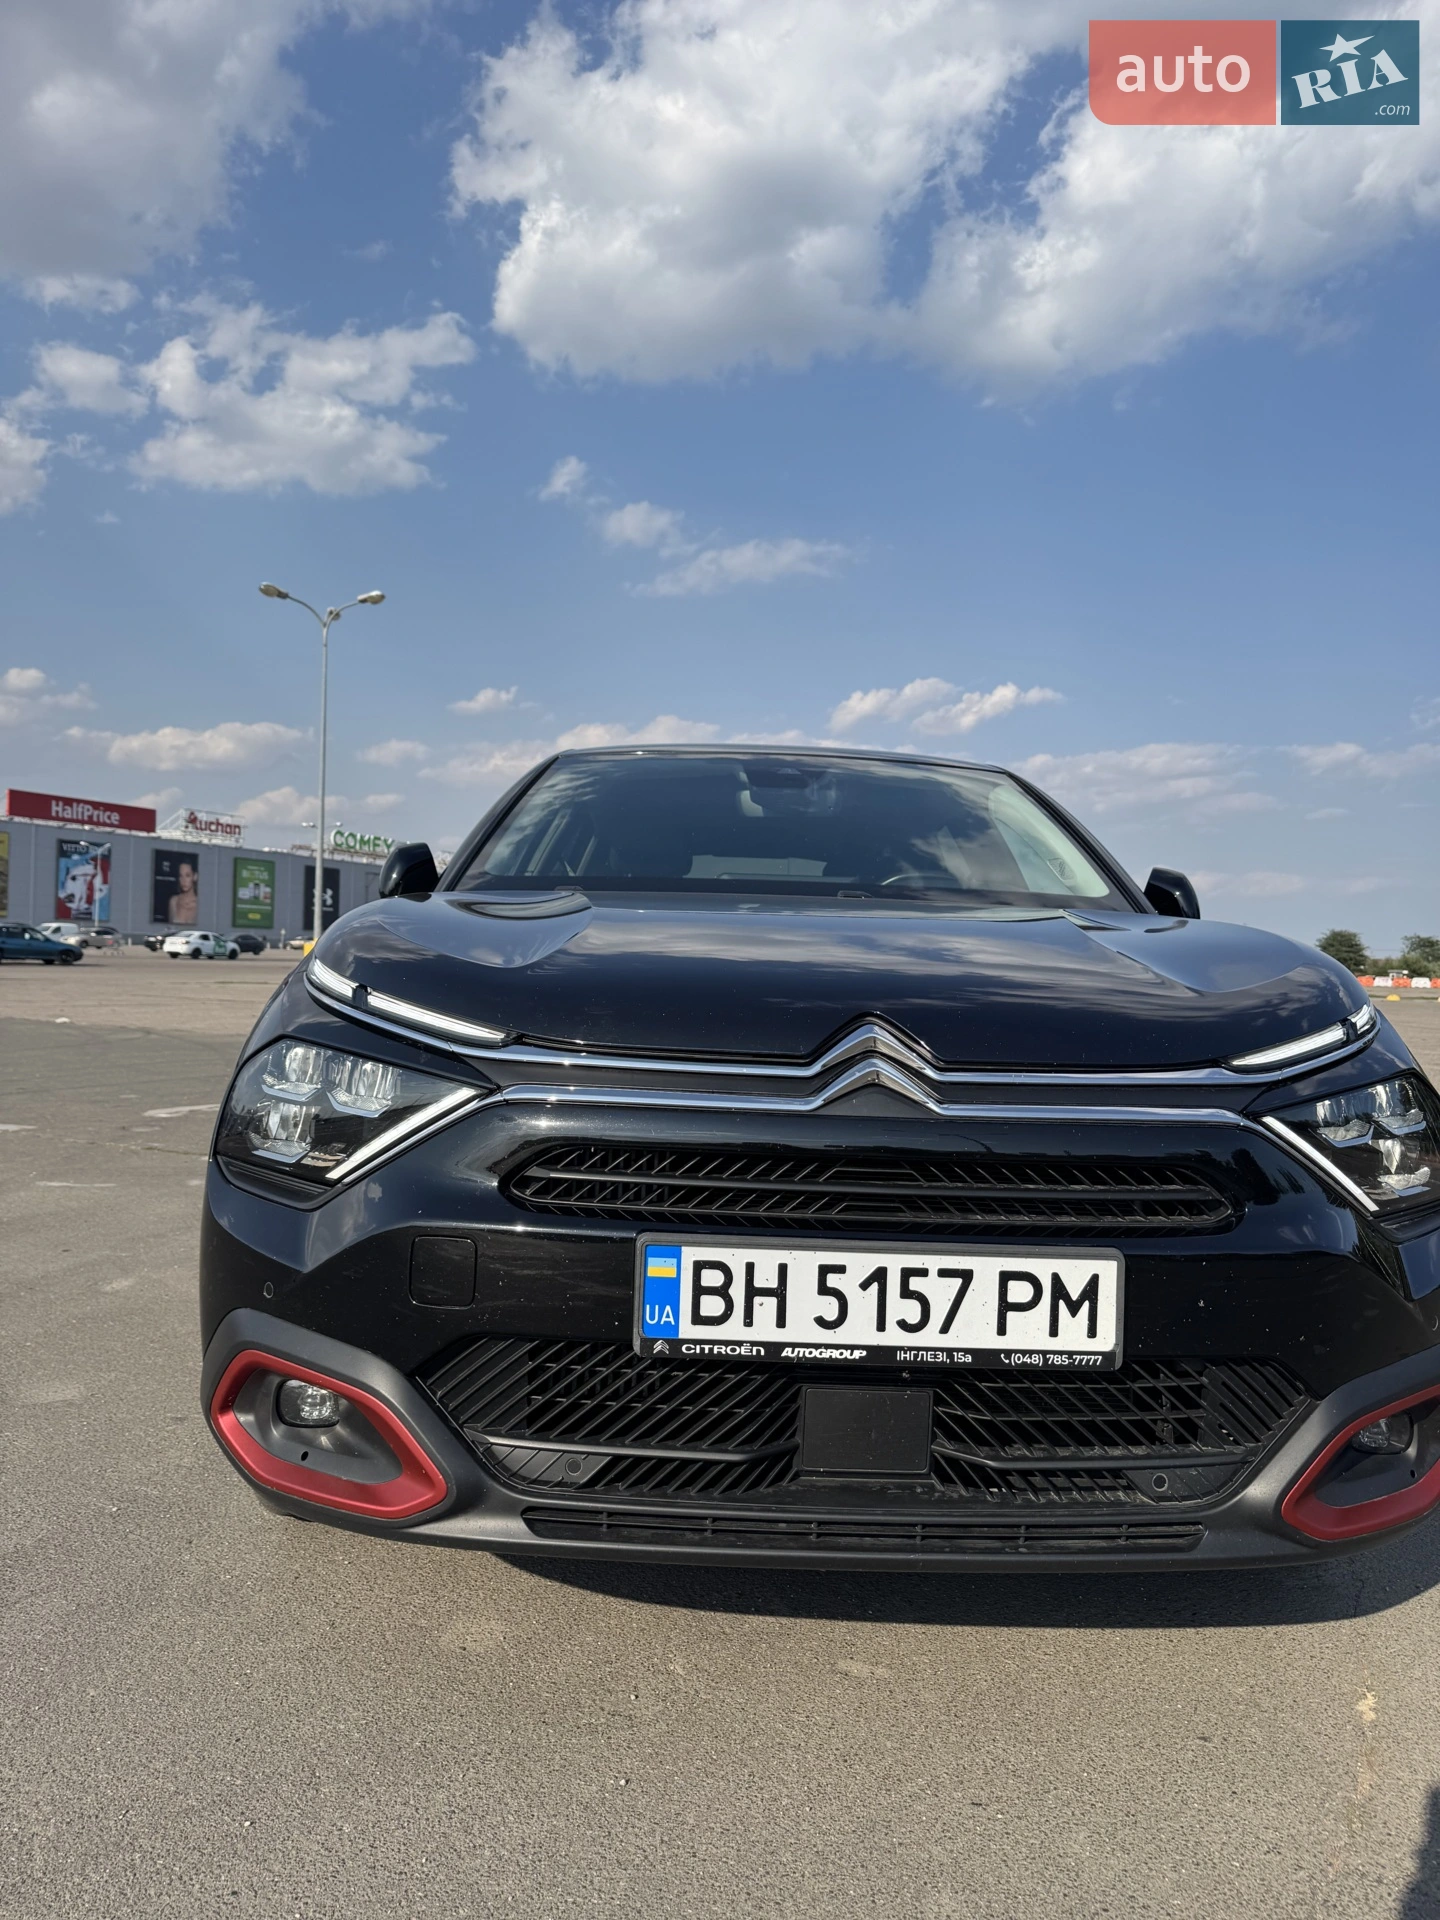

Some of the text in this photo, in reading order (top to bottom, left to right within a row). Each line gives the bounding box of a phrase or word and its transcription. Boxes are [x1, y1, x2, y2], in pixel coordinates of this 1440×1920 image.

[51, 800, 120, 825] HalfPrice
[184, 811, 241, 836] Auchan
[331, 829, 396, 853] COMFY
[690, 1259, 1100, 1339] BH 5157 PM
[645, 1304, 675, 1326] UA
[781, 1346, 867, 1360] AUTOGROUP
[896, 1351, 950, 1364] ІНГЛЕЗІ,
[1010, 1353, 1102, 1366] (048) 785-7777
